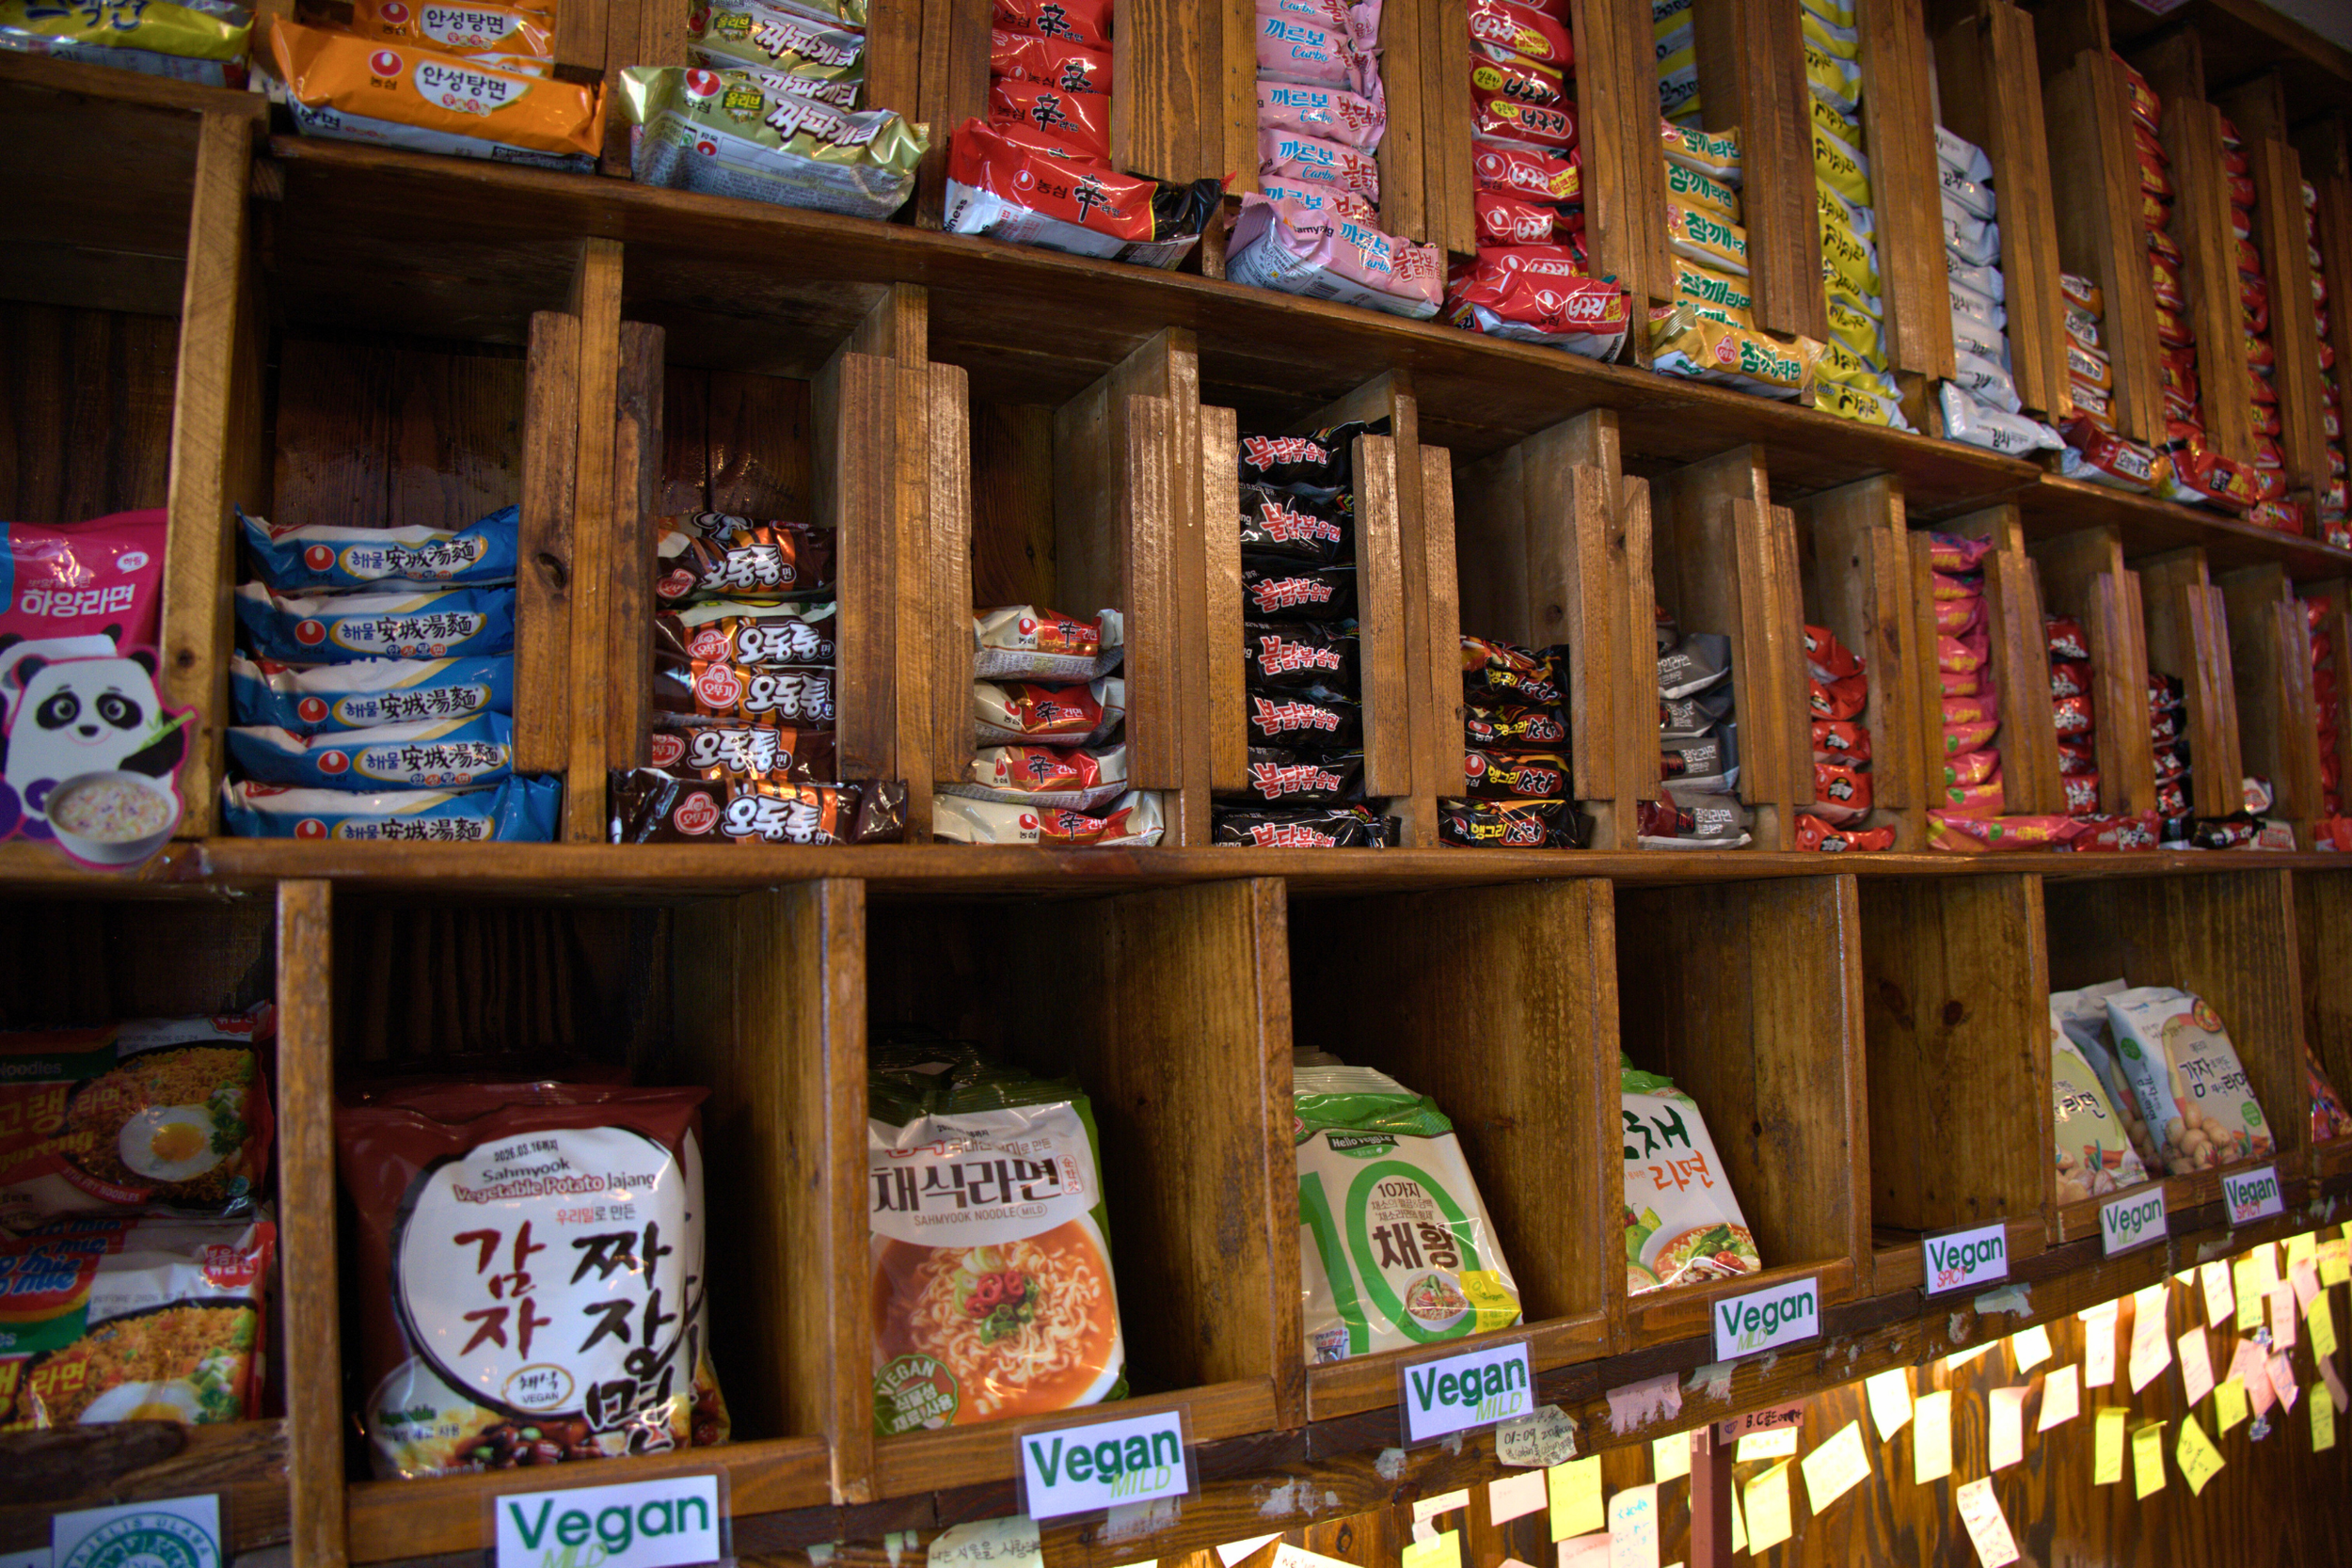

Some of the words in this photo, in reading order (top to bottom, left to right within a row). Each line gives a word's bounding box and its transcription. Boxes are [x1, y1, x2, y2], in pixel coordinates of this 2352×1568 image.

[426, 9, 504, 35] 안성탕면
[715, 15, 752, 30] 올리브
[1003, 10, 1031, 29] 농심
[1036, 3, 1072, 39] 辛
[1263, 19, 1326, 48] 까르보
[755, 19, 862, 69] 짜파게티
[1291, 44, 1328, 63] Carbo
[422, 65, 508, 101] 안성탕면
[1271, 89, 1330, 109] 까르보
[723, 89, 765, 110] 올리브
[1032, 93, 1066, 133] 辛
[765, 97, 883, 147] 짜파게티
[1058, 119, 1080, 133] 라면
[1299, 109, 1334, 125] Carbo
[1521, 108, 1565, 135] 너구리
[1279, 140, 1335, 167] 까르보
[1036, 179, 1069, 200] 농심
[1302, 165, 1336, 182] Carbo
[1511, 162, 1549, 189] 너구리
[1668, 164, 1732, 208] 참깨라면
[1073, 173, 1108, 223] 辛
[1339, 221, 1391, 261] 까르보
[1568, 294, 1606, 320] 너구리
[1739, 339, 1802, 381] 참깨라면
[1244, 436, 1328, 472] 불닭볶음면
[1260, 502, 1343, 544] 불닭볶음면
[352, 548, 385, 570] 해물
[385, 539, 475, 572] 安城湯麵
[700, 543, 796, 589] 오동통면
[20, 583, 137, 618] 하양라면
[1252, 577, 1334, 613] 불닭볶음면
[342, 623, 375, 641] 해물
[376, 610, 473, 643] 安城湯麵
[1057, 620, 1081, 648] 辛
[1081, 627, 1098, 641] 건면
[698, 643, 726, 658] 오뚜기
[736, 621, 835, 665] 오동통면
[1257, 635, 1341, 675] 불닭볶음면
[345, 701, 379, 718] 해물
[379, 686, 477, 720] 安城湯麵
[704, 683, 734, 699] 오뚜기
[744, 673, 835, 720] 오동통면
[1036, 701, 1060, 727] 辛
[1061, 706, 1084, 719] 건면
[1251, 697, 1340, 736] 불닭볶음면
[366, 753, 401, 771] 해물
[401, 741, 499, 772] 安城湯麵
[688, 727, 792, 773] 오동통면
[1680, 744, 1716, 763] 장인라면
[1027, 754, 1054, 784] 辛
[1252, 762, 1343, 800] 불닭볶음면
[1487, 764, 1520, 786] 앵그리
[682, 813, 712, 827] 오뚜기
[721, 795, 831, 846] 오동통면
[1058, 811, 1086, 841] 辛
[1470, 822, 1508, 841] 앵그리
[1694, 807, 1733, 824] 장인라면
[1019, 830, 1038, 840] 농심
[1331, 1135, 1359, 1149] Hello
[1357, 1133, 1393, 1148] veggie
[482, 1157, 572, 1183] Sahmyook
[870, 1157, 1062, 1213] 채식라면
[1647, 1148, 1715, 1193] 라면
[81, 1176, 98, 1192] FRY
[98, 1183, 140, 1204] NOODLES
[453, 1179, 542, 1203] Vegetable
[544, 1174, 606, 1196] Potato
[607, 1171, 657, 1191] Jajang
[1377, 1181, 1422, 1198] 10가지
[2226, 1175, 2278, 1207] Vegan
[555, 1207, 608, 1225] 우리밀로
[610, 1203, 636, 1221] 만든
[914, 1211, 973, 1227] SAHMYOOK
[975, 1206, 1017, 1222] NOODLE
[1021, 1204, 1045, 1217] MILD
[2106, 1196, 2164, 1235] Vegan
[2235, 1200, 2263, 1221] SPICY
[1372, 1220, 1460, 1271] 채황
[1929, 1235, 2004, 1275] Vegan
[453, 1219, 552, 1361] 감자
[1936, 1264, 1970, 1289] SPICY
[1720, 1290, 1815, 1338] Vegan
[568, 1220, 677, 1457] 짜장면
[1736, 1326, 1769, 1353] MILD
[32, 1358, 87, 1397] 라면
[877, 1360, 937, 1398] VEGAN
[1409, 1356, 1527, 1412] Vegan
[521, 1390, 560, 1404] VEGAN
[1474, 1392, 1524, 1422] MILD
[1028, 1429, 1183, 1490] Vegan
[1109, 1464, 1173, 1499] MILD
[508, 1492, 709, 1556] Vegan
